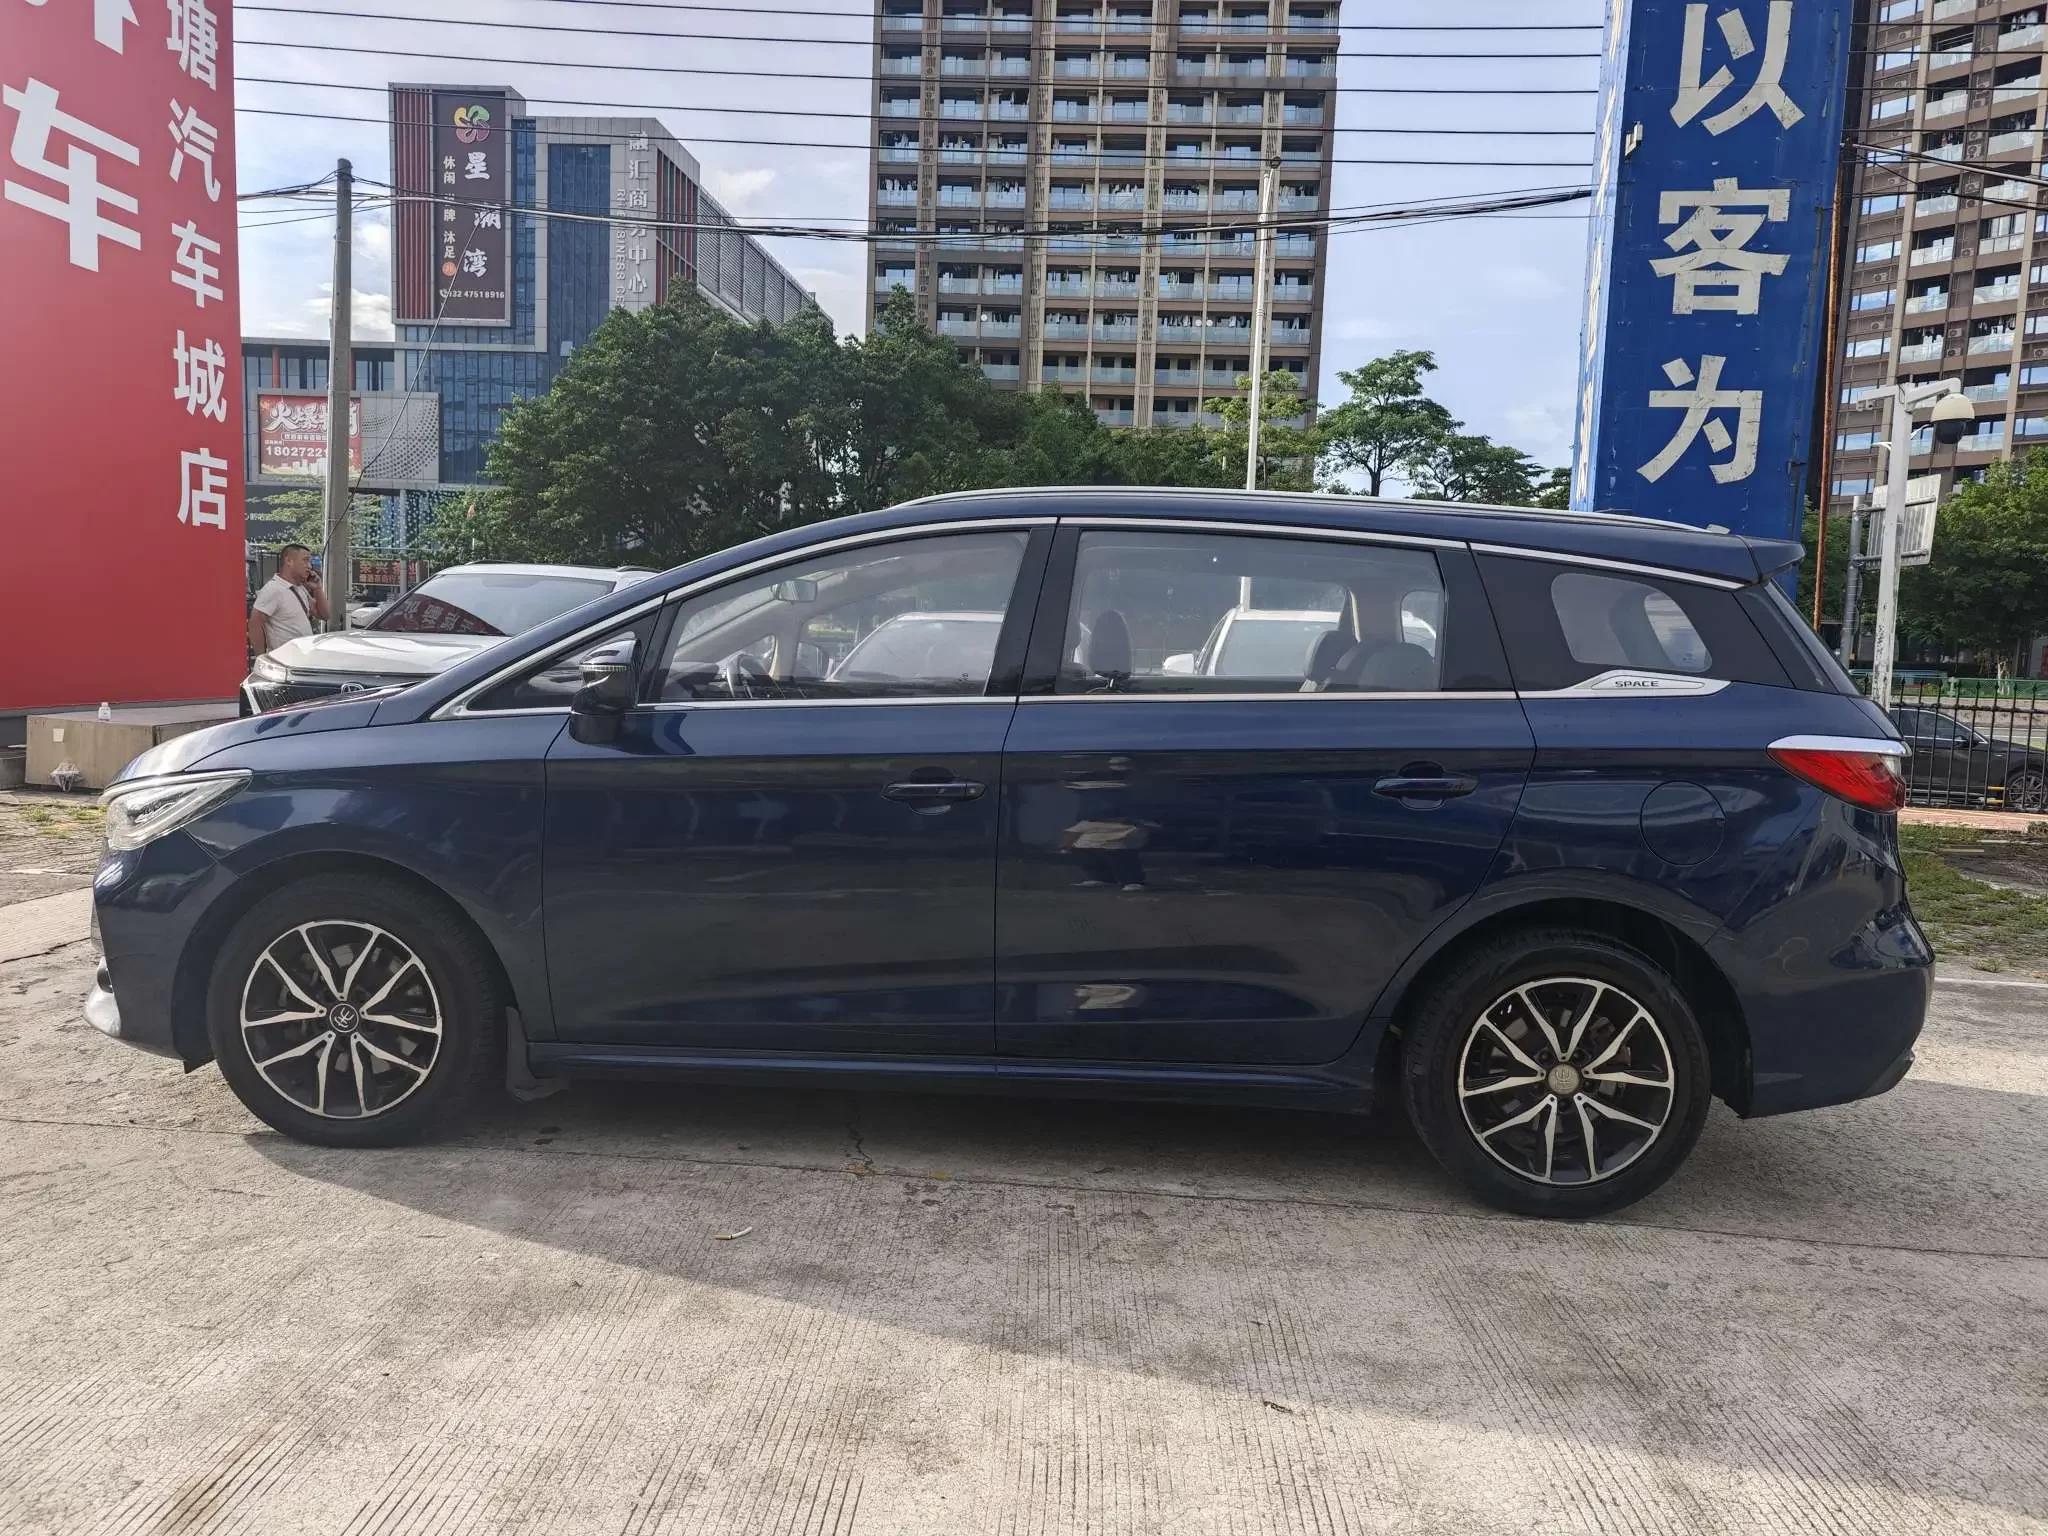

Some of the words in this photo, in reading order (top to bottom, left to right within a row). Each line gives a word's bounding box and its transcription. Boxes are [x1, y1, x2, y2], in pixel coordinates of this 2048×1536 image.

[2, 0, 142, 272] 车
[443, 155, 456, 184] 休闲
[166, 0, 229, 531] 塘汽车城店
[443, 230, 456, 259] 沐足
[1636, 2, 1806, 534] 以客为
[1614, 680, 1660, 688] SPACE
